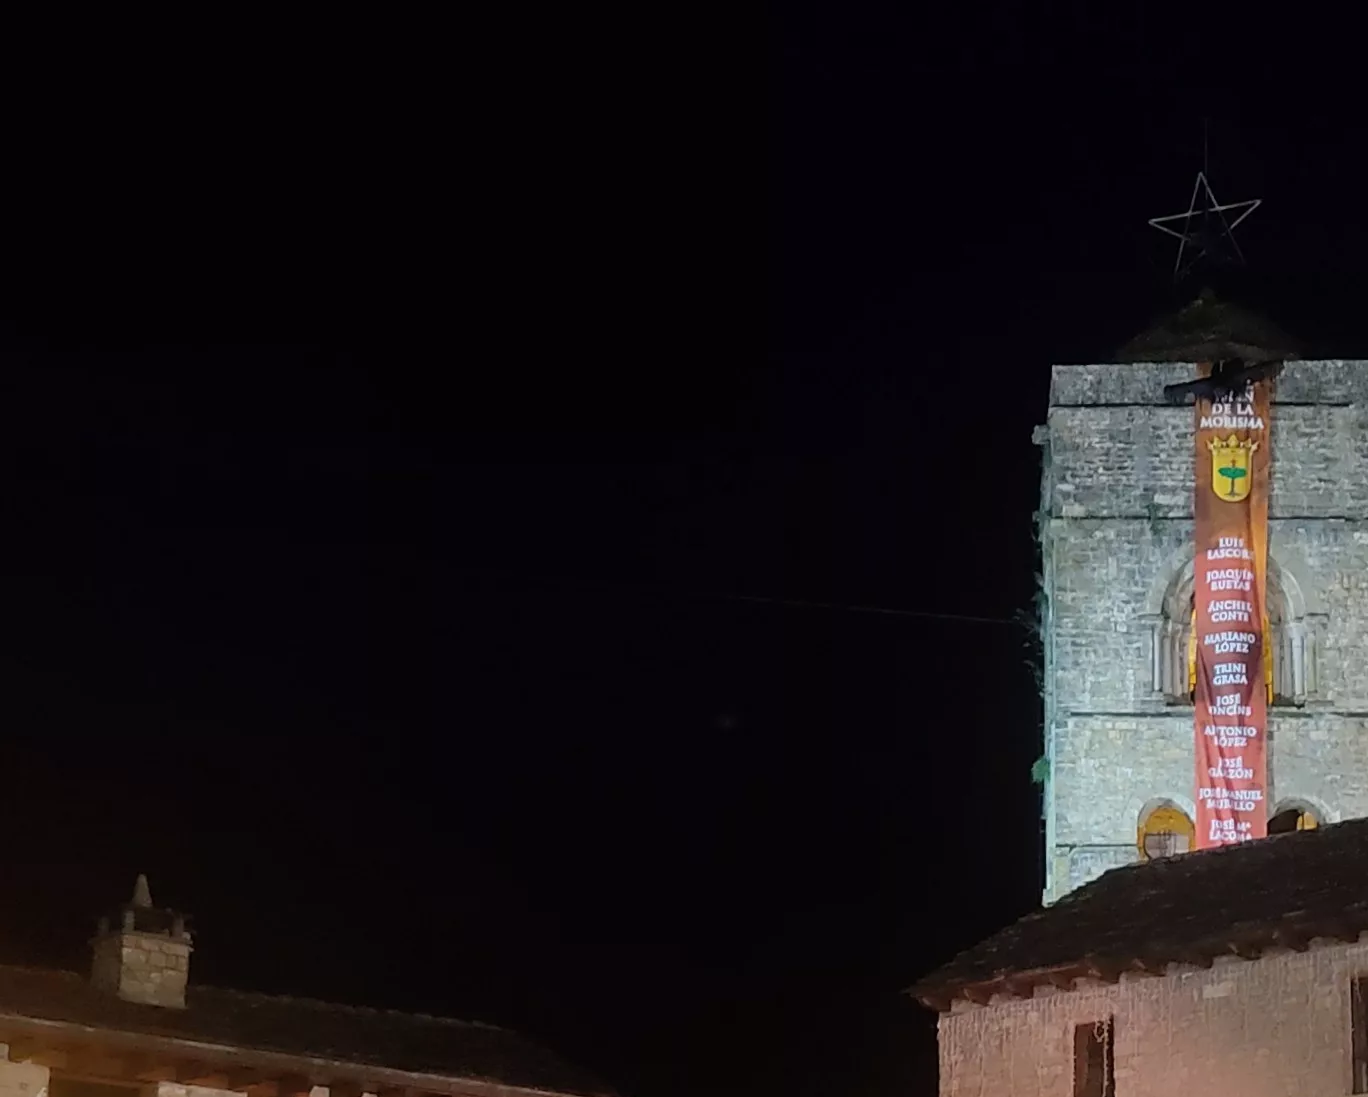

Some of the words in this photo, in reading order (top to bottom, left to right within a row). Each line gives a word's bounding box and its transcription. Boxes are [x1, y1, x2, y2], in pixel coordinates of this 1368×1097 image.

[1212, 403, 1231, 415] DE
[1237, 403, 1254, 415] LA
[1200, 416, 1264, 429] MORISMA
[1219, 537, 1245, 548] LUIS
[1204, 629, 1256, 645] MARIANO
[1215, 642, 1249, 654] LÓPEZ
[1214, 663, 1246, 675] TRINI
[1213, 674, 1248, 686] GRASA
[1213, 735, 1248, 748] LÓPEZ
